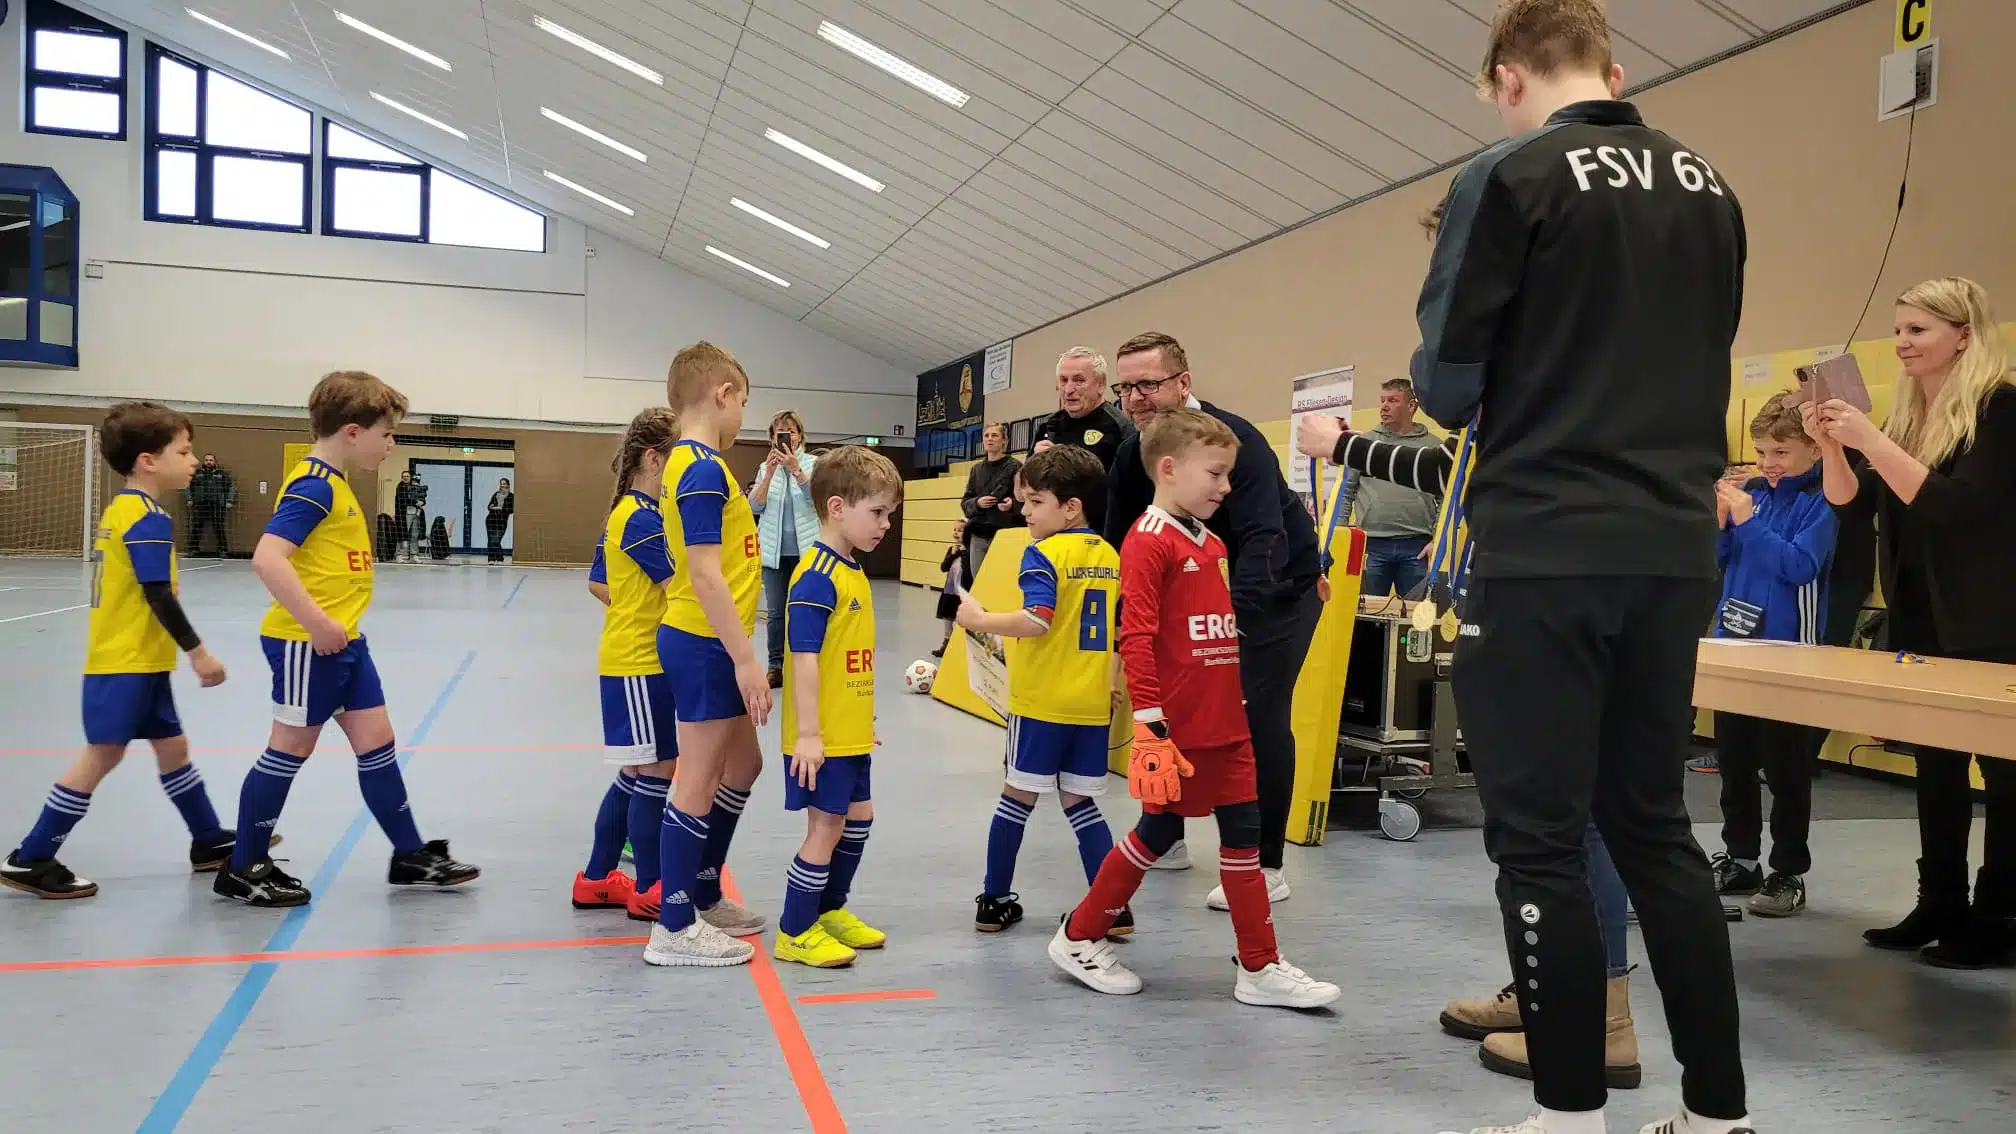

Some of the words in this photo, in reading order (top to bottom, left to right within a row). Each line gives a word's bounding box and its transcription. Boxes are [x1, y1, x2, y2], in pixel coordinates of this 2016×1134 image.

[1902, 0, 1926, 42] C
[1565, 145, 1653, 191] FSV
[1671, 151, 1724, 196] 63
[1079, 588, 1107, 652] 8
[846, 648, 874, 673] ER
